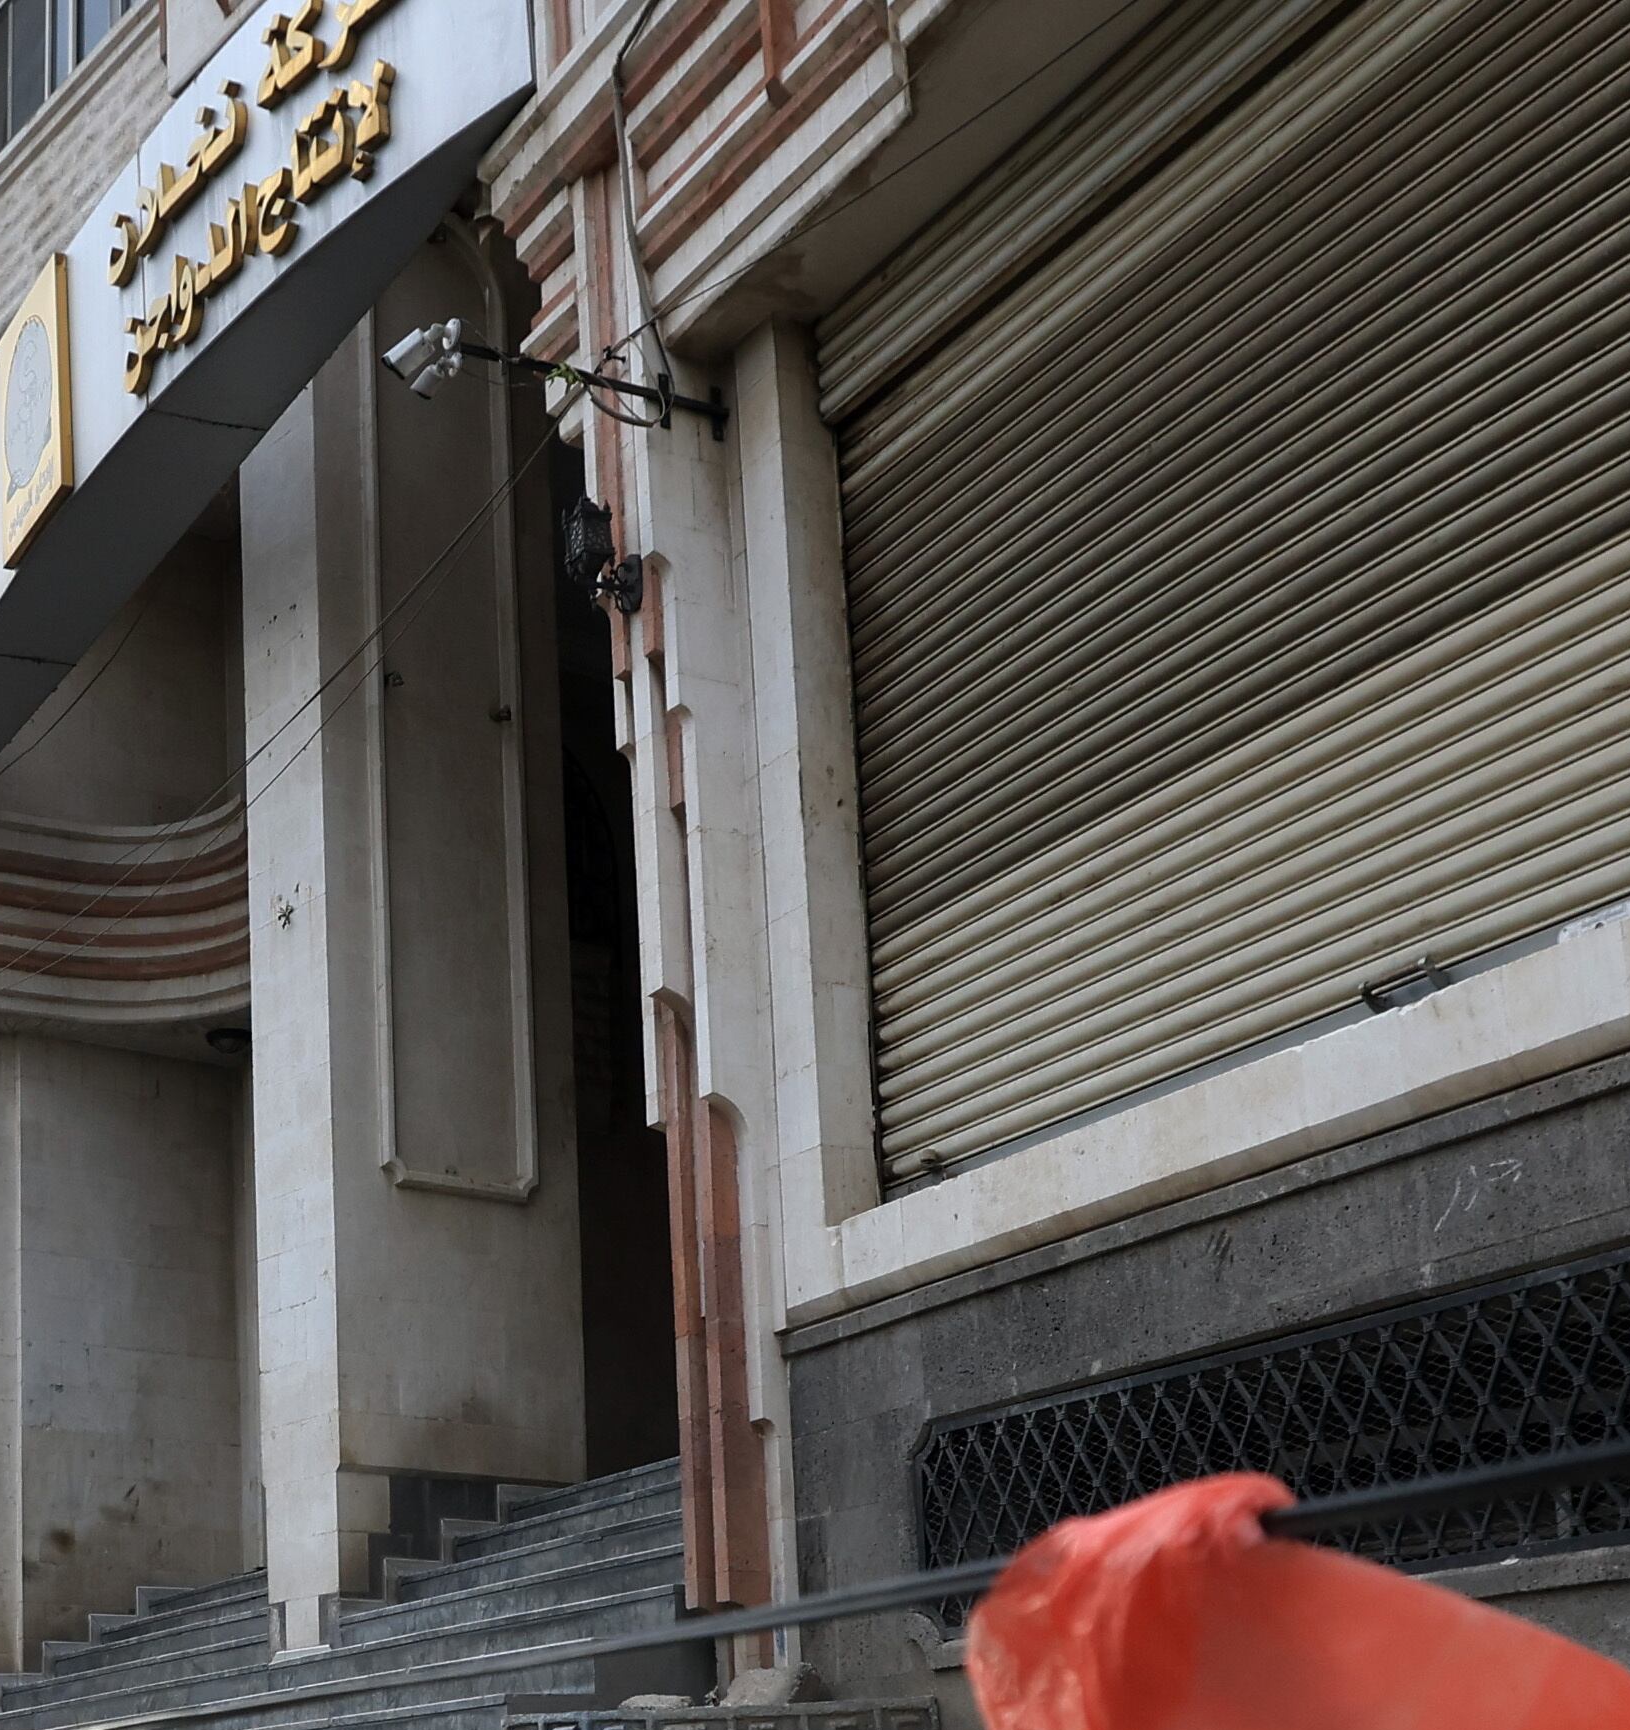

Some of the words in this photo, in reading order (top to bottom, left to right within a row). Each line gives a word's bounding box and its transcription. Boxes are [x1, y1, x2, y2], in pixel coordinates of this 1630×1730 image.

[257, 0, 399, 110] ركة
[256, 58, 397, 257] لإنتاج
[123, 182, 259, 394] الدواجن
